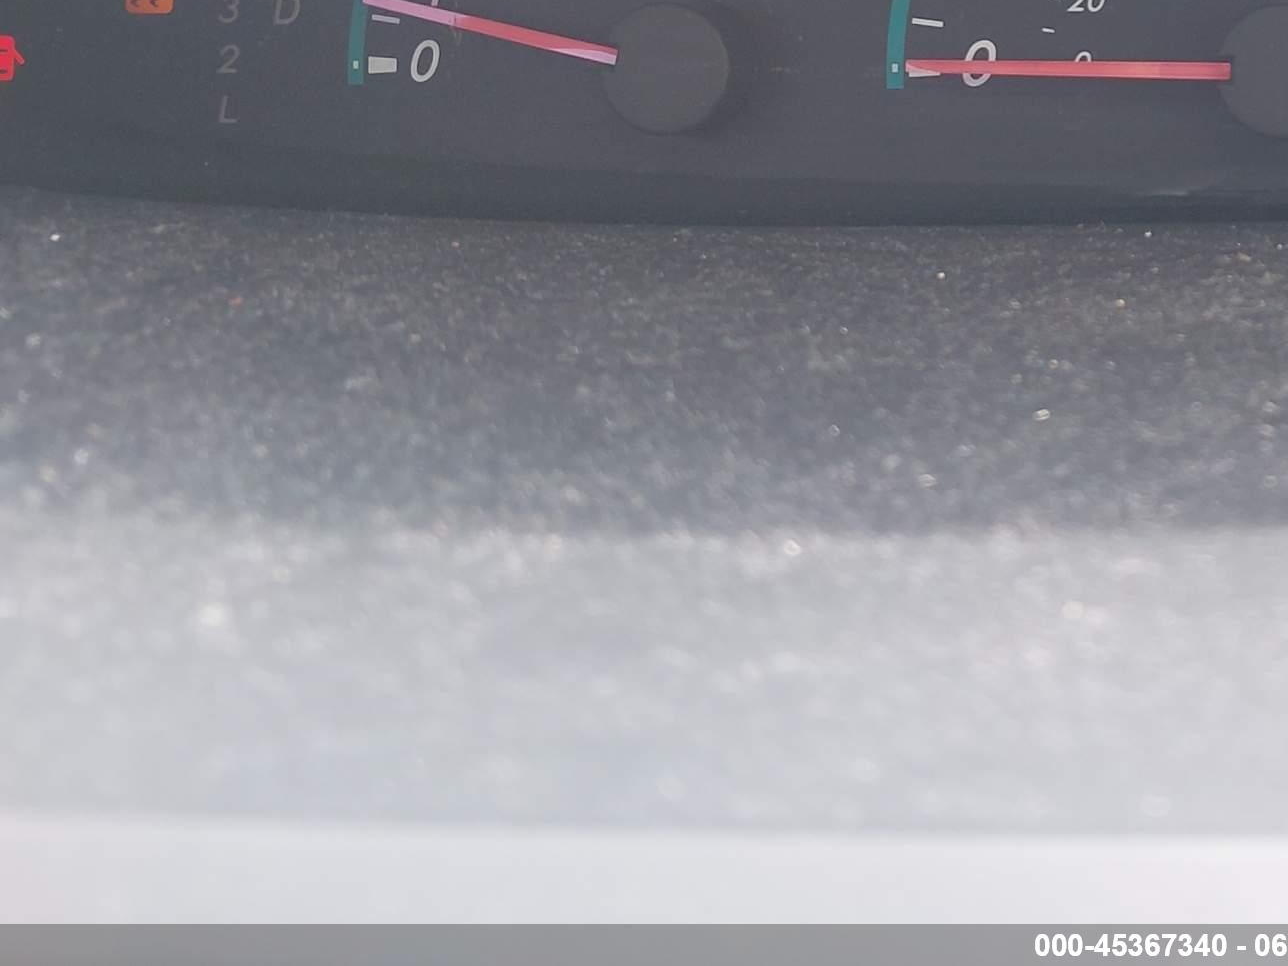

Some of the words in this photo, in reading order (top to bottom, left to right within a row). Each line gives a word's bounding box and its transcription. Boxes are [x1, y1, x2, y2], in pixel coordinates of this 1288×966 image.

[217, 45, 240, 74] 2
[410, 39, 440, 83] 0
[962, 40, 998, 87] 0
[218, 95, 238, 124] L
